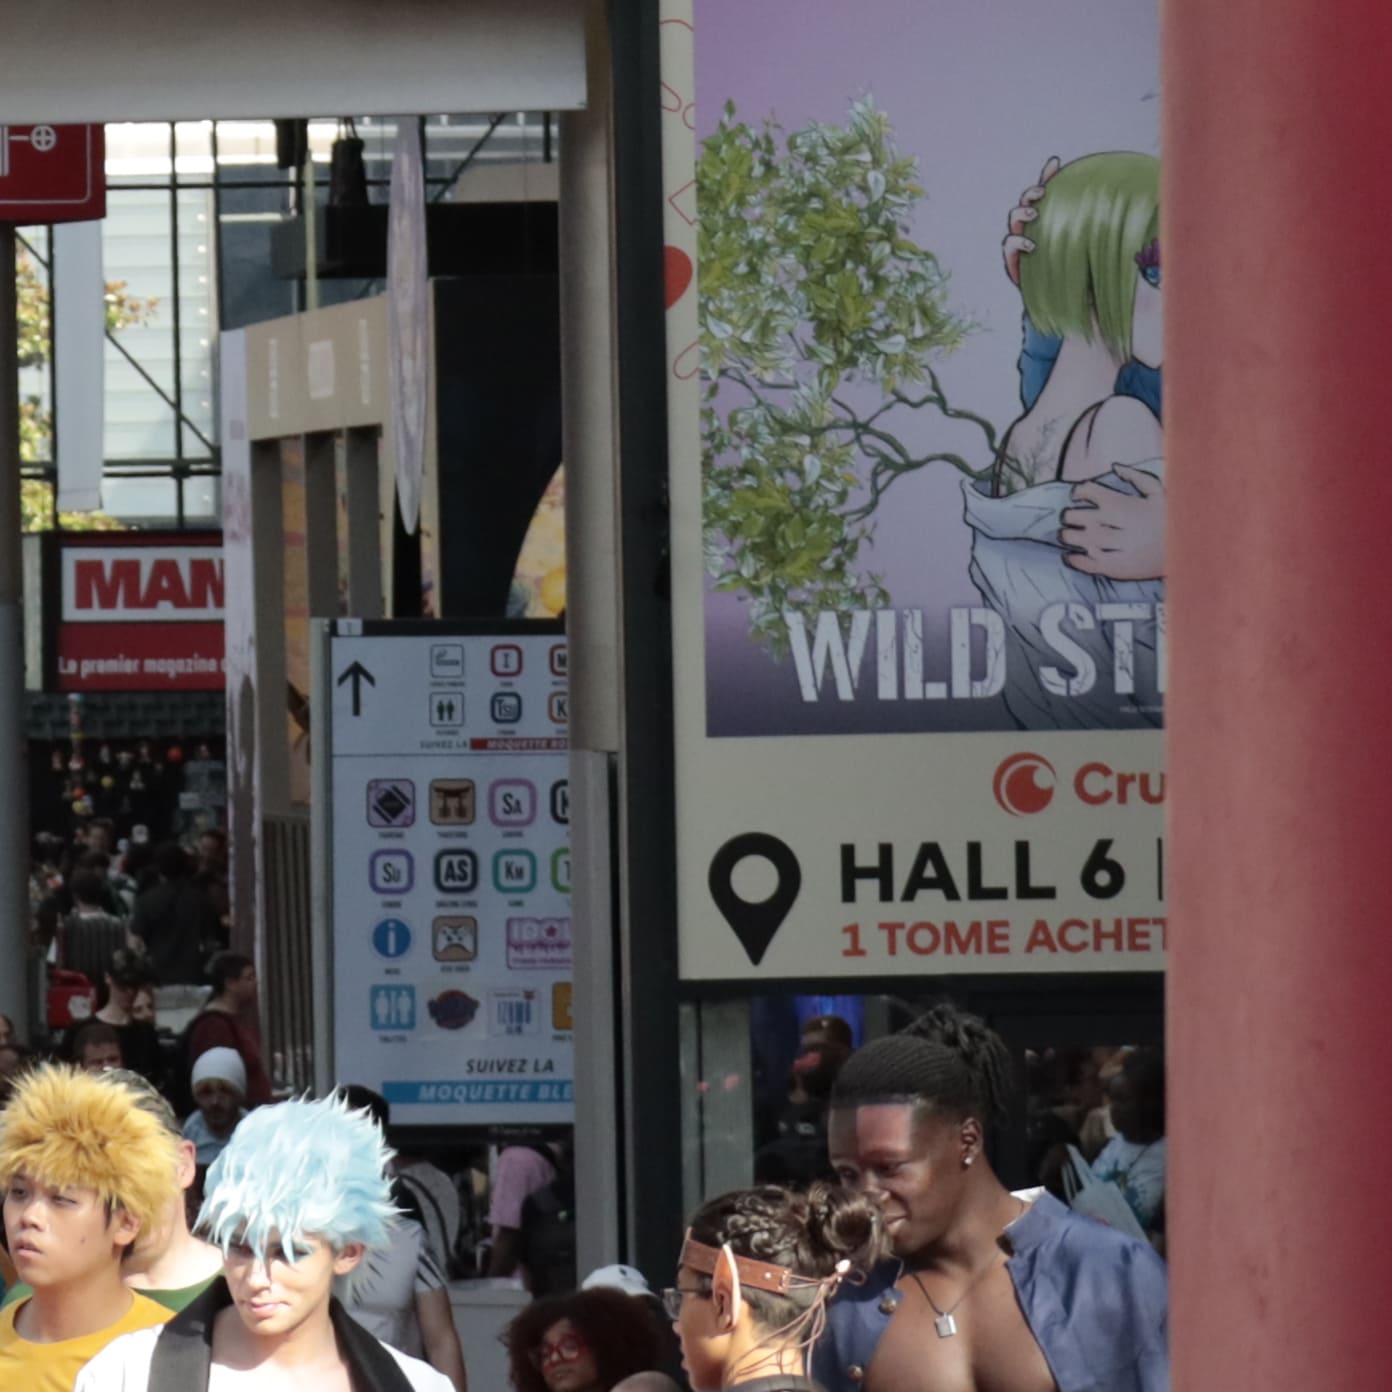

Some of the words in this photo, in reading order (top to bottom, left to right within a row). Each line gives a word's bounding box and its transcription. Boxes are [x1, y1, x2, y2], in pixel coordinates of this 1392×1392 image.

[75, 559, 224, 609] MAN
[58, 656, 78, 674] Le
[81, 653, 140, 679] premier
[144, 653, 217, 679] magazine
[782, 607, 1007, 702] WILD
[1039, 602, 1167, 697] ST
[841, 840, 1056, 903] HALL
[1080, 838, 1126, 900] 6
[841, 923, 867, 957] 1
[878, 920, 1009, 957] TOME
[466, 1058, 529, 1074] SUIVEZ
[533, 1058, 555, 1074] LA
[419, 1084, 529, 1104] MOQUETTE
